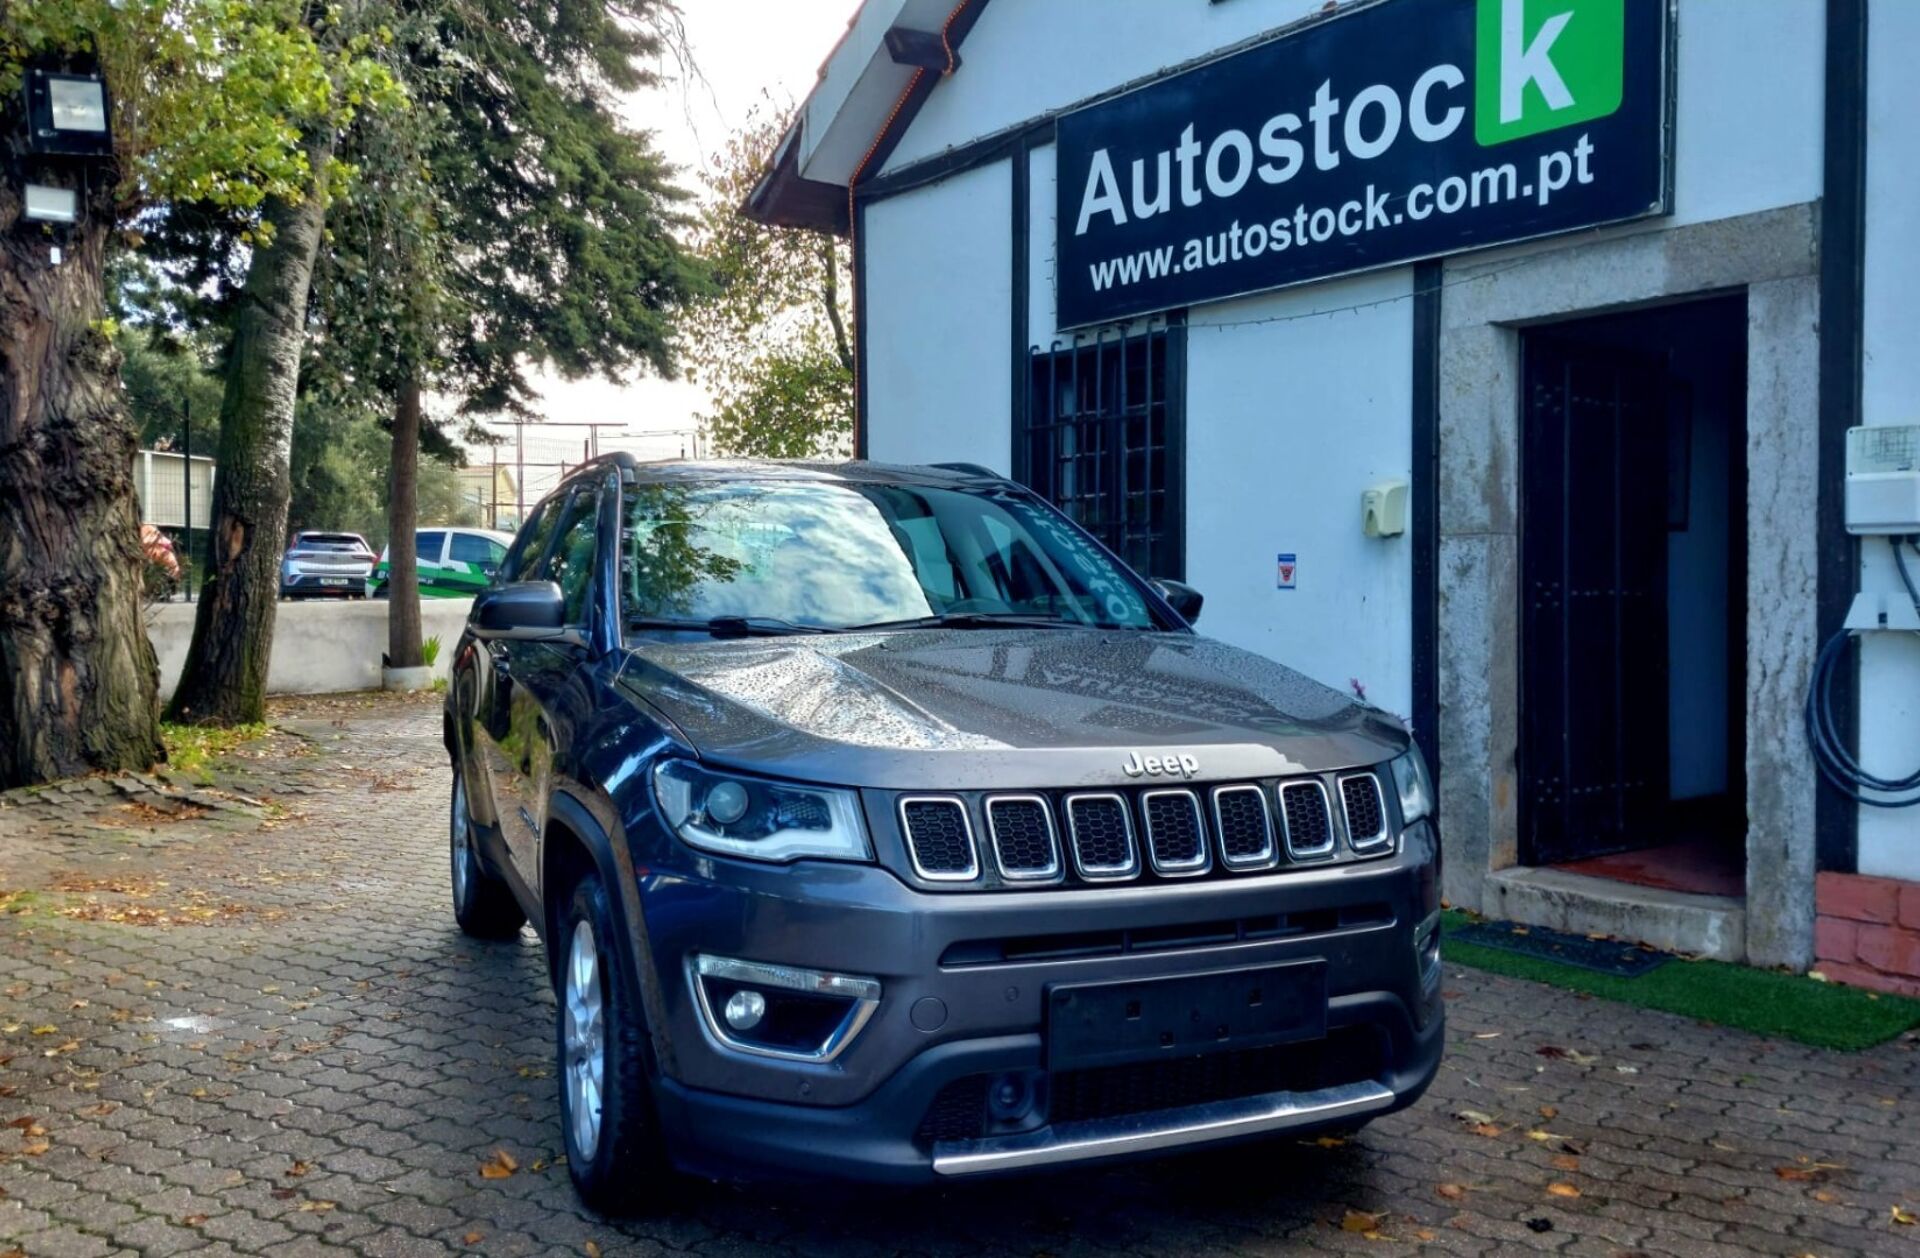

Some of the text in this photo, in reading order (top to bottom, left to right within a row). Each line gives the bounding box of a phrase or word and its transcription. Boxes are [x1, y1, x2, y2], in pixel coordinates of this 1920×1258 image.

[1075, 0, 1575, 235] Autostock
[1090, 133, 1594, 291] www.autostock.com.pt
[1122, 751, 1200, 779] Jeep
